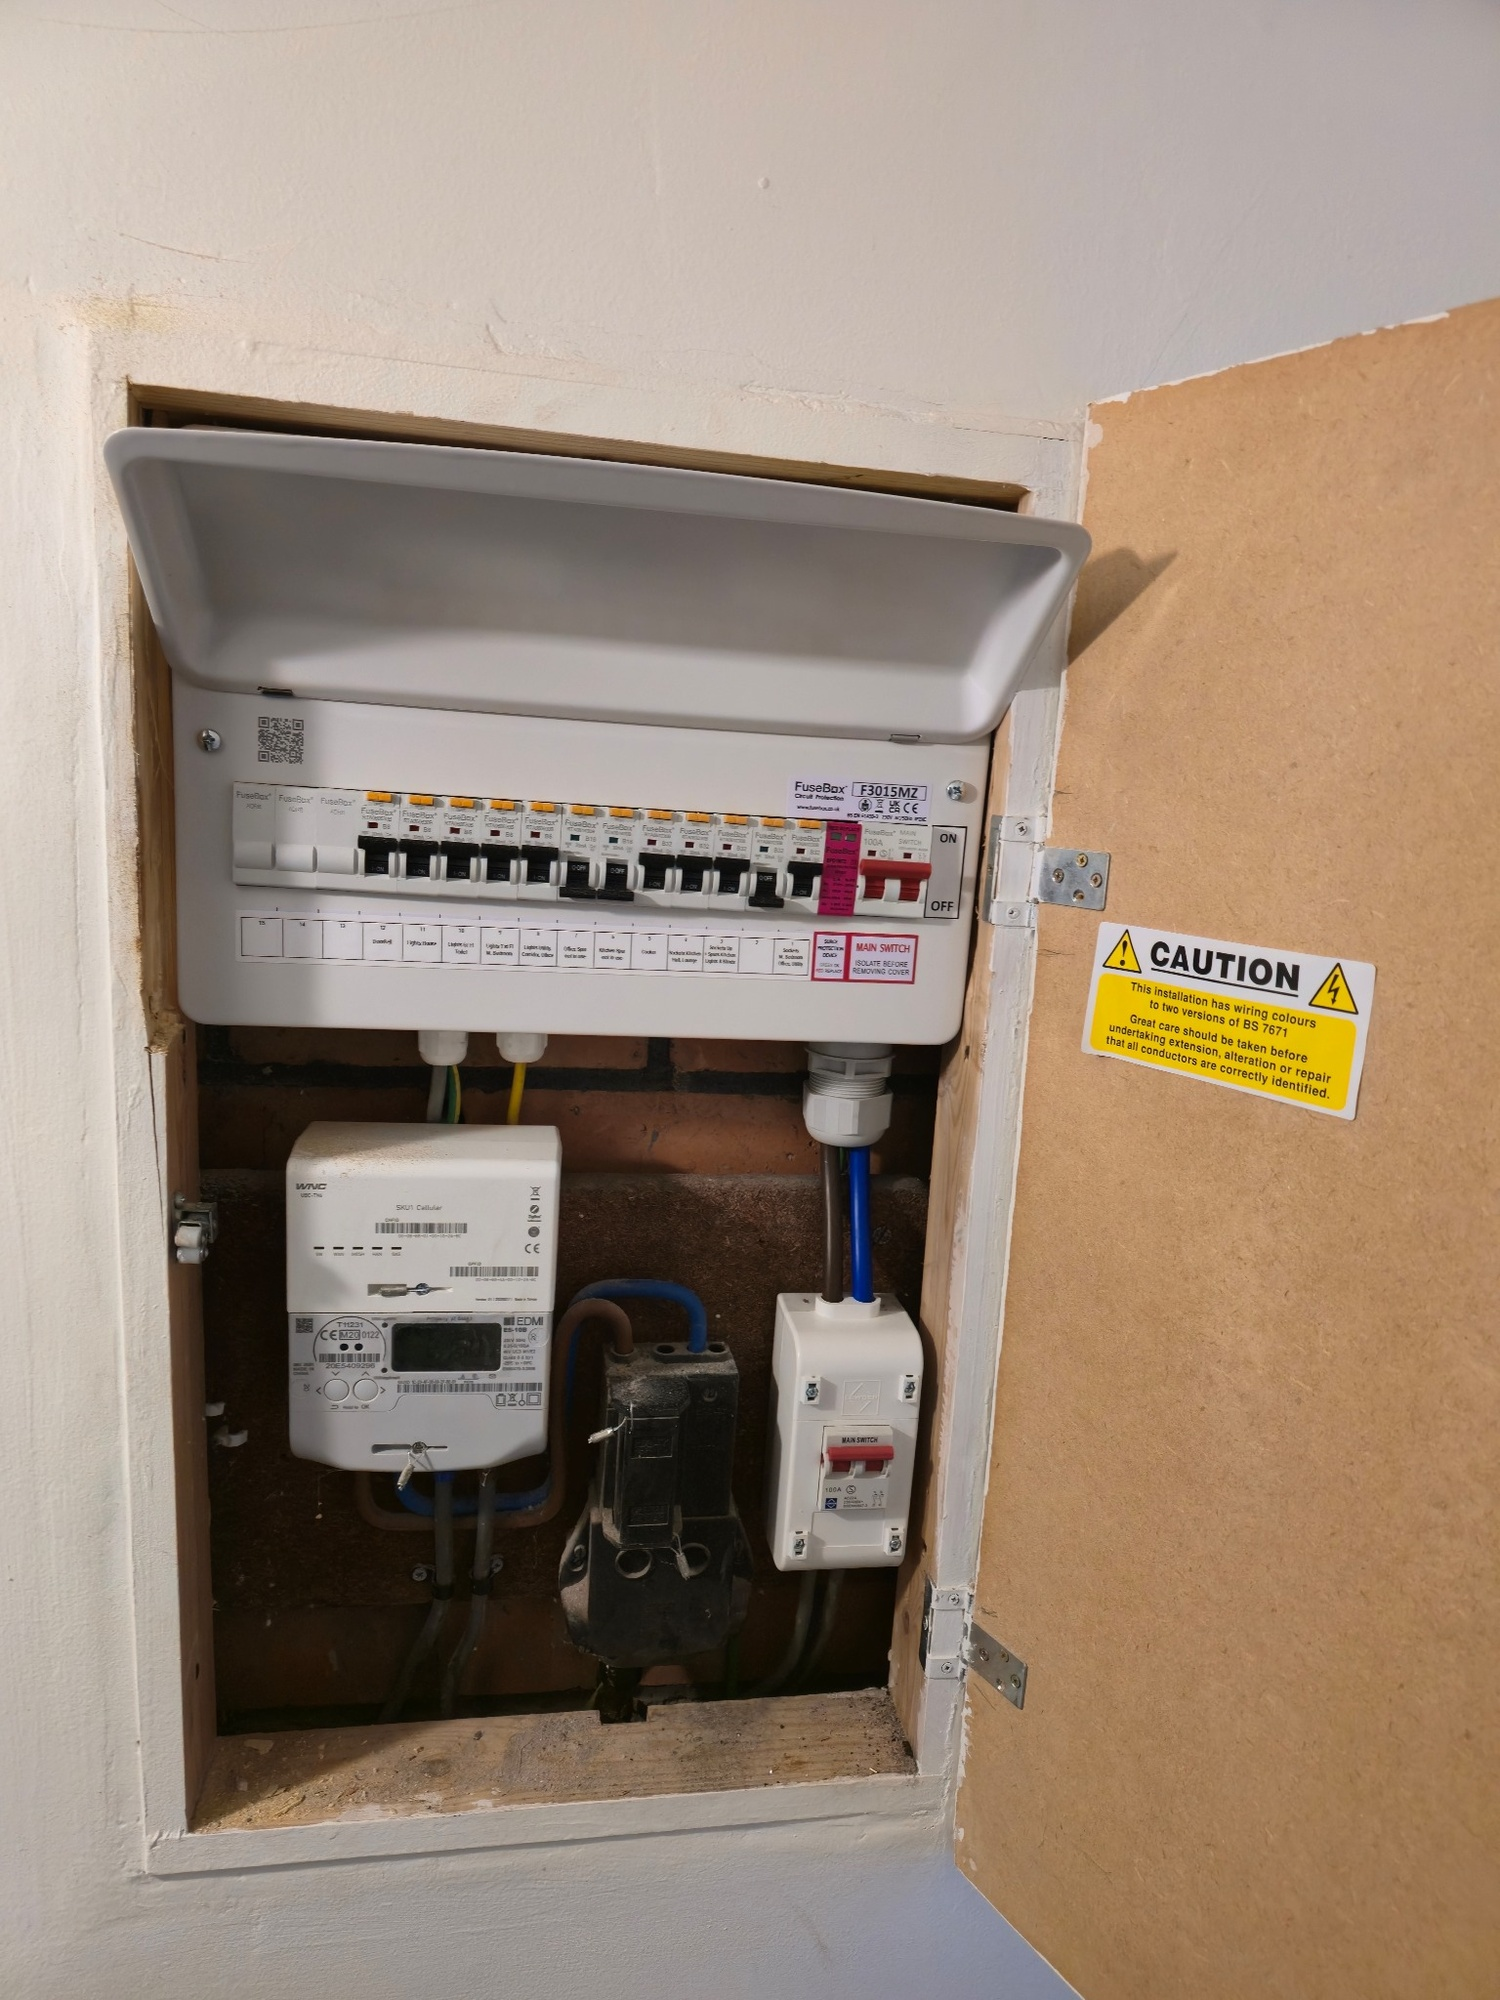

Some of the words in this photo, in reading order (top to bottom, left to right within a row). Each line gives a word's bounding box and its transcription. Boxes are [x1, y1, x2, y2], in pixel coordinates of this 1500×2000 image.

[795, 781, 845, 794] FuseBox
[860, 784, 918, 798] F3015MZ
[864, 838, 883, 846] 100A
[939, 834, 957, 843] ON
[930, 901, 954, 911] OFF
[856, 943, 877, 952] MAIN
[879, 943, 911, 953] SWITCH
[883, 960, 909, 968] BEFORE
[1150, 940, 1300, 992] CAUTION
[852, 967, 886, 975] REMOVING
[888, 968, 910, 976] COVER
[1130, 981, 1152, 996] This
[1154, 986, 1209, 1008] installation
[1211, 998, 1231, 1012] has
[1233, 1002, 1268, 1021] wiring
[1271, 1009, 1317, 1029] colours
[1149, 999, 1160, 1010] to
[1162, 1002, 1180, 1015] two
[1182, 1008, 1226, 1026] versions
[1229, 1016, 1241, 1028] of
[1243, 1018, 1260, 1031] BS
[1262, 1023, 1289, 1038] 7671
[1129, 1014, 1156, 1030] Great
[1158, 1022, 1180, 1034] care
[1182, 1025, 1218, 1044] should
[1220, 1034, 1235, 1047] be
[1236, 1038, 1268, 1054] taken
[1270, 1044, 1309, 1063] before
[1108, 1023, 1167, 1047] undertaking
[1168, 1038, 1222, 1059] extension,
[1223, 1050, 1277, 1072] alteration
[1279, 1064, 1293, 1075] or
[1295, 1068, 1332, 1085] repair
[1106, 1035, 1125, 1048] that
[1127, 1039, 1139, 1051] all
[1140, 1043, 1198, 1067] conductors
[1200, 1059, 1218, 1071] are
[1219, 1062, 1269, 1086] correctly
[1271, 1075, 1331, 1100] identified.
[517, 1316, 543, 1326] EDMI
[340, 1331, 360, 1339] M20
[361, 1330, 379, 1339] 0122
[841, 1436, 856, 1444] MAIN
[857, 1436, 878, 1444] SWITCH
